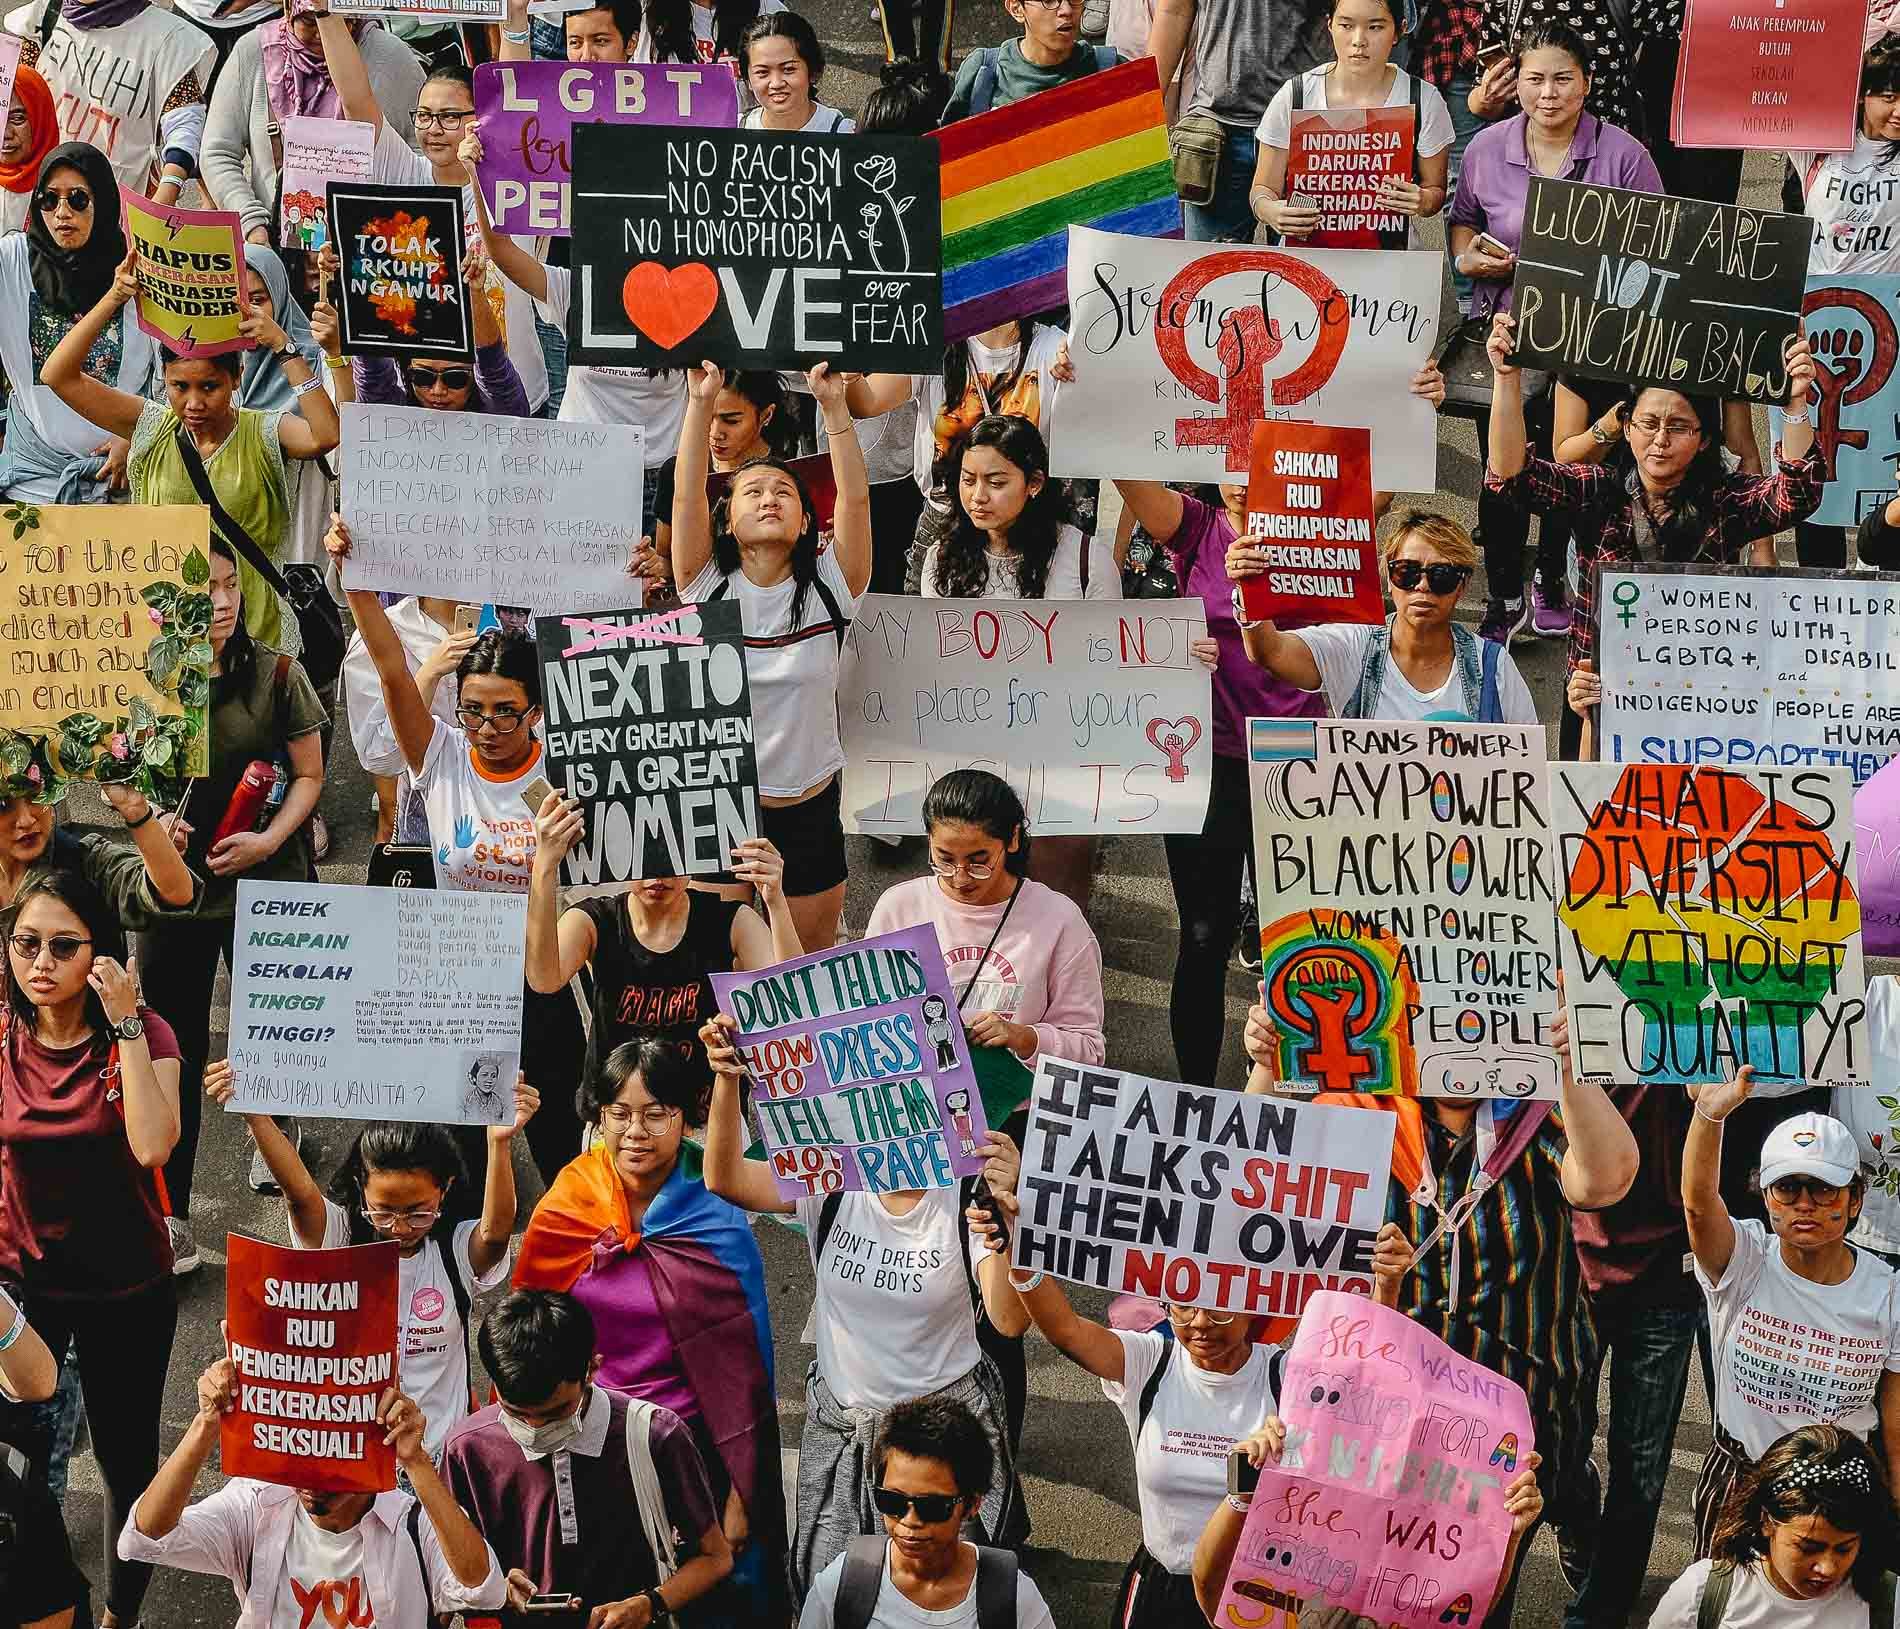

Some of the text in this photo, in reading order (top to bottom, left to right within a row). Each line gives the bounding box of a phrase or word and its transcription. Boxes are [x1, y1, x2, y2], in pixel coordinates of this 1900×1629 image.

[1730, 15, 1825, 32] ANAK PEREMPUAN
[1759, 42, 1792, 56] BUTUH
[1752, 91, 1788, 104] BUKAN
[1302, 131, 1402, 151] INDONESIA
[666, 140, 841, 187] NO RACISM
[1308, 154, 1395, 172] DARURAT
[666, 181, 831, 221] NO SEXISM
[1826, 177, 1898, 205] FIGHT
[1532, 183, 1786, 281] WOMEN ARE
[1840, 208, 1874, 222] like
[133, 232, 232, 271] HAPUS
[354, 235, 441, 257] TOLAK
[624, 219, 852, 260] NO HOMOPHOBIA
[1833, 226, 1892, 253] GIRL
[135, 266, 238, 299] BERBASIS
[360, 258, 439, 280] RKUHP
[1593, 255, 1680, 317] NOT
[351, 278, 458, 305] NGAWUR
[865, 281, 911, 298] over
[851, 304, 928, 345] FEAR
[1077, 262, 1245, 379] Strong
[1515, 286, 1692, 381] PUNCHING
[358, 416, 377, 443] 1
[384, 416, 448, 442] DARI
[459, 415, 479, 441] 3
[481, 423, 608, 449] PEREMPUAN
[359, 450, 585, 474] INDONESIA PERNAH
[1273, 450, 1338, 479] SAHKAN
[356, 480, 555, 505] MENJADI KORBAN
[1286, 484, 1321, 509] RUU
[1248, 512, 1370, 542] PENGHAPUSAN
[24, 540, 137, 573] for the
[1269, 573, 1354, 599] SEKSUAL!
[1, 611, 132, 641] dictated
[850, 609, 1208, 666] MY BODY is NOT
[1645, 618, 1834, 640] PERSONS WITH
[12, 648, 88, 674] much
[1778, 672, 1808, 682] and
[36, 682, 129, 709] endure
[545, 643, 743, 725] NEXT TO
[863, 678, 1158, 748] a place for your
[1616, 694, 1900, 722] INDIGENOUS PEOPLE ARE
[548, 716, 752, 758] EVERY GREAT MEN
[1320, 726, 1530, 758] TRANS POWER!
[565, 748, 745, 799] IS A GREAT
[1281, 759, 1548, 829] GAY POWER
[1559, 767, 1836, 832] WHAT IS
[568, 786, 758, 885] WOMEN
[1271, 831, 1553, 902] BLACK POWER
[1559, 833, 1851, 923] DIVERSITY
[250, 900, 332, 918] CEWEK
[1309, 906, 1539, 945] WOMEN POWER
[248, 932, 350, 950] NGAPAIN
[248, 963, 352, 981] SEKOLAH
[1393, 945, 1558, 992] ALL POWER
[1572, 928, 1847, 995] WITHOUT
[248, 993, 326, 1011] TINGGI
[731, 962, 816, 1033] DON'T
[824, 949, 889, 1010] TELL
[889, 949, 926, 995] US
[1451, 989, 1526, 1006] TO THE
[247, 1025, 335, 1043] TINGGI?
[1406, 1004, 1553, 1046] PEOPLE
[1574, 998, 1866, 1081] EQUALITY?
[235, 1050, 327, 1072] Apa gunanya
[744, 1015, 921, 1086] HOW DRESS
[334, 1080, 405, 1109] WANITA
[756, 1069, 806, 1098] TO
[759, 1078, 943, 1147] TELL THEM
[1037, 1062, 1297, 1157] IF A MAN
[772, 1134, 954, 1193] NOT RAPE
[798, 1169, 844, 1195] TO
[1035, 1116, 1370, 1225] TALKS SHIT
[1026, 1176, 1379, 1274] THEN I OWE
[831, 1223, 942, 1269] DON'T DRESS
[1017, 1228, 1112, 1287] HIM
[831, 1257, 923, 1293] FOR BOYS
[264, 1278, 358, 1311] SAHKAN
[286, 1319, 335, 1349] RUU
[1745, 1306, 1883, 1350] POWER IS THE PEOPLE
[231, 1347, 391, 1386] PENGHAPUSAN
[1319, 1314, 1413, 1382] She
[1735, 1349, 1875, 1392] POWER IS THE PEOPLE
[241, 1384, 377, 1424] KEKERASAN
[253, 1423, 364, 1461] SEKSUAL!
[1418, 1400, 1519, 1472] FOR A
[1256, 1485, 1463, 1561] She WAS
[1367, 1565, 1473, 1625] FOR A
